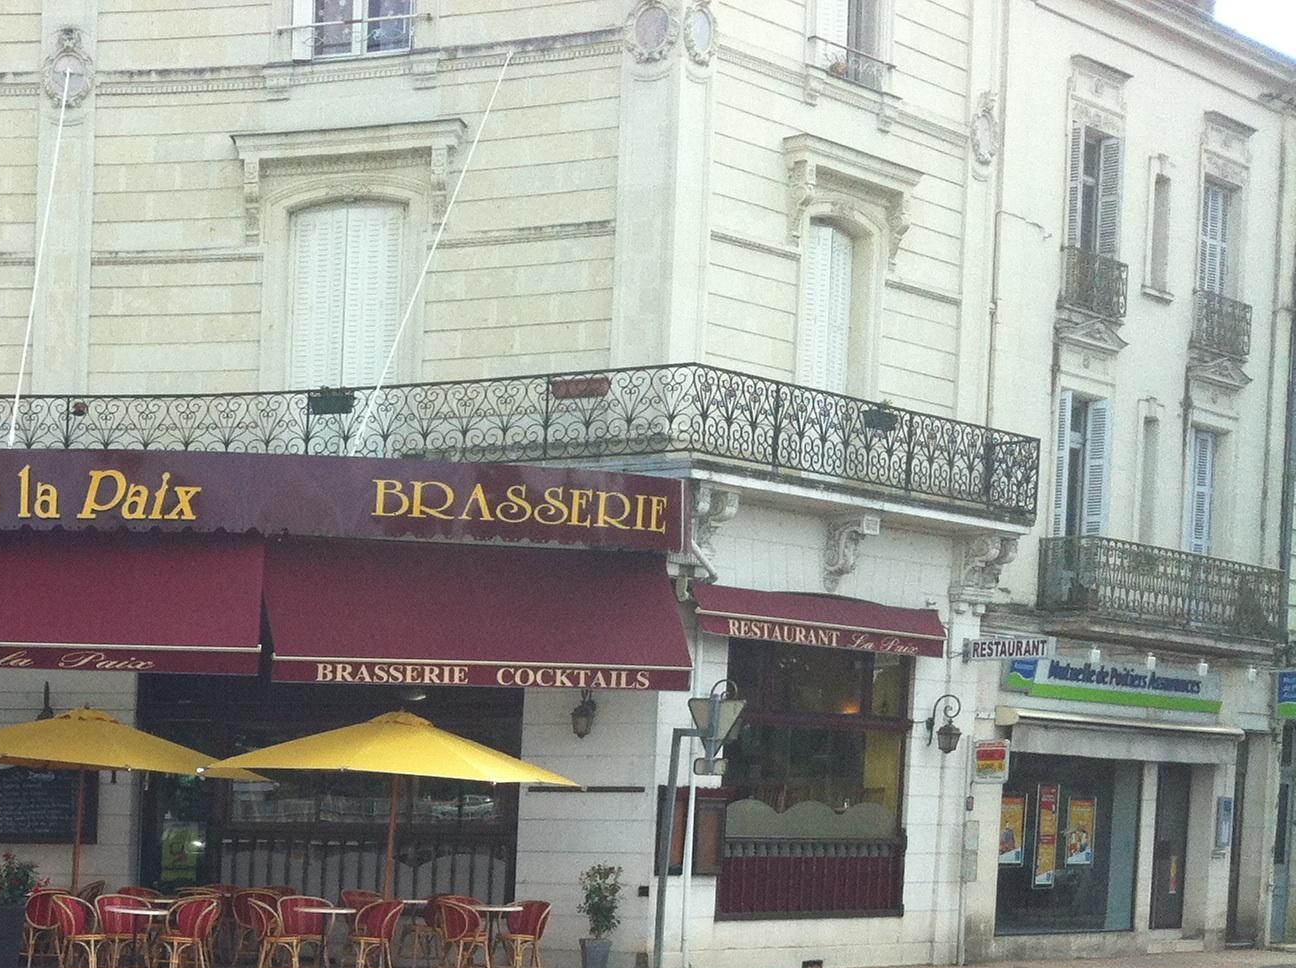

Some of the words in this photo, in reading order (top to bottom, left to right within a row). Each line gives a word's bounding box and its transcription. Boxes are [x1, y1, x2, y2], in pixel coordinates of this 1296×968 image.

[17, 464, 61, 519] la
[76, 469, 203, 520] Paix
[371, 479, 668, 535] BRASSERIE
[728, 618, 840, 647] RESTAURANT
[850, 633, 875, 650] La
[880, 636, 919, 656] Paix
[972, 639, 1048, 658] RESTAURANT
[58, 650, 156, 670] Paix
[315, 662, 469, 685] BRASSERIE
[496, 667, 650, 690] COCKTAILS
[1048, 659, 1096, 684] Mutuelle
[1096, 665, 1110, 685] de
[1110, 667, 1147, 689] Poitiers
[1147, 671, 1202, 694] Assurances
